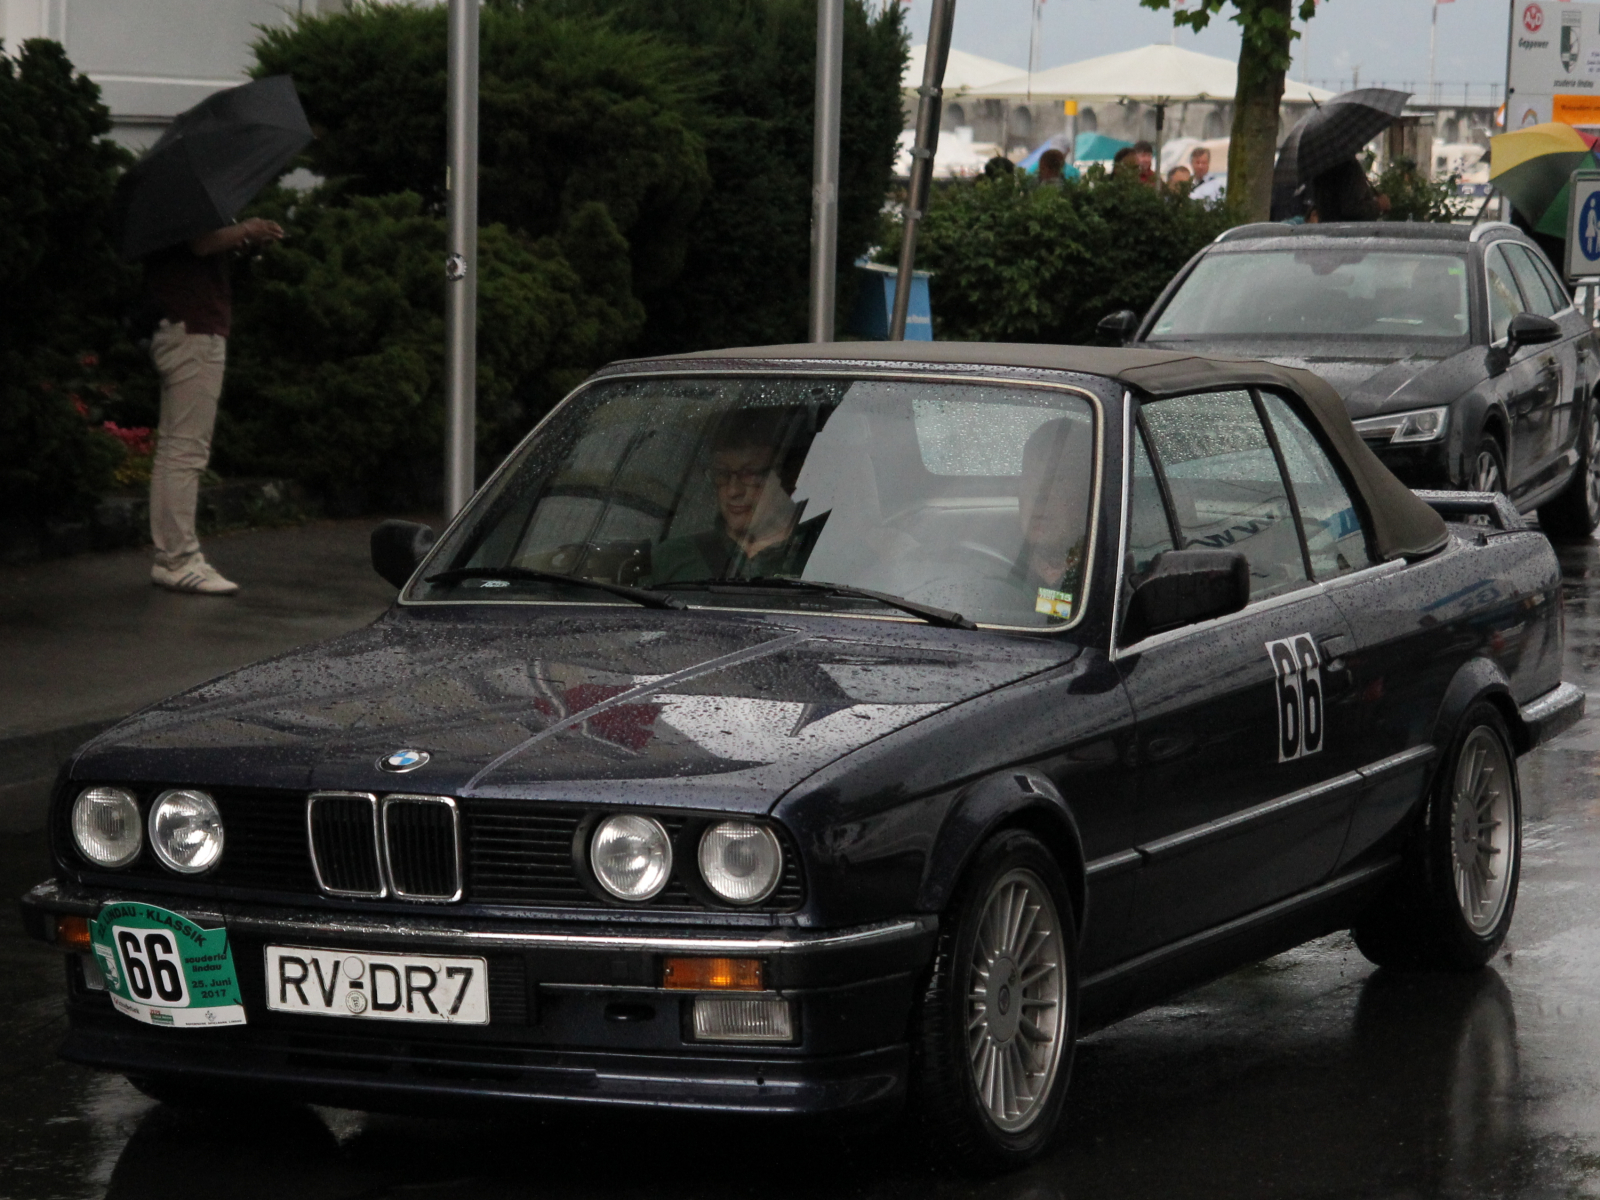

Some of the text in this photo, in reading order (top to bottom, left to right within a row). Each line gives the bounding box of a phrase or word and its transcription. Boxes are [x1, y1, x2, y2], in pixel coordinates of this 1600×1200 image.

[1272, 636, 1321, 759] 66
[103, 906, 136, 925] LINDAU
[146, 909, 207, 948] KLASSIK
[118, 930, 183, 1003] 66
[192, 964, 222, 972] lindau
[191, 977, 231, 989] 25. Juni
[201, 989, 226, 999] 2017
